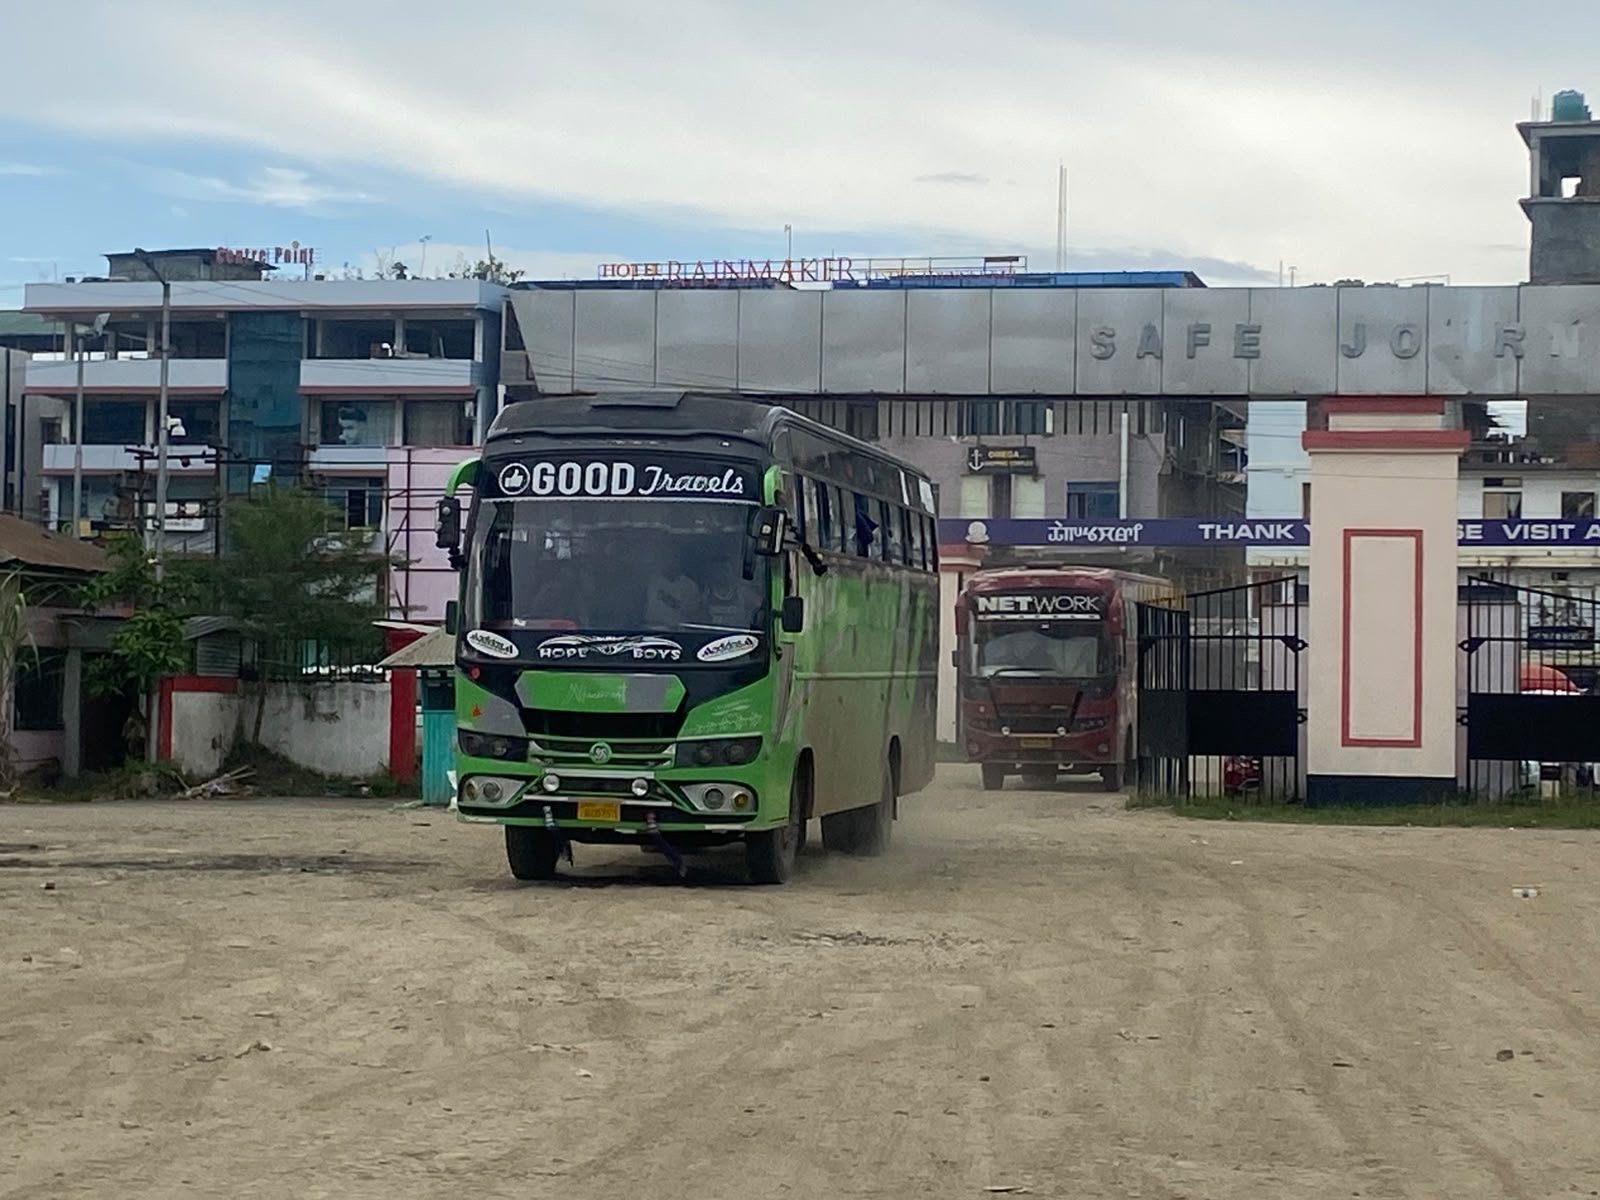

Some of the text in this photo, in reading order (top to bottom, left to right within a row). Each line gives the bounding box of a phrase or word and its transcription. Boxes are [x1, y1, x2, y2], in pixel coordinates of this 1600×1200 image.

[274, 241, 314, 264] Point
[667, 257, 855, 282] RAINMAKER
[1091, 322, 1261, 359] SAFE
[531, 462, 744, 495] GOOD Travels
[1198, 523, 1296, 540] THANK
[1502, 524, 1575, 540] VISIT
[977, 595, 1101, 613] NETWORK
[539, 647, 681, 660] HOPE BOYS
